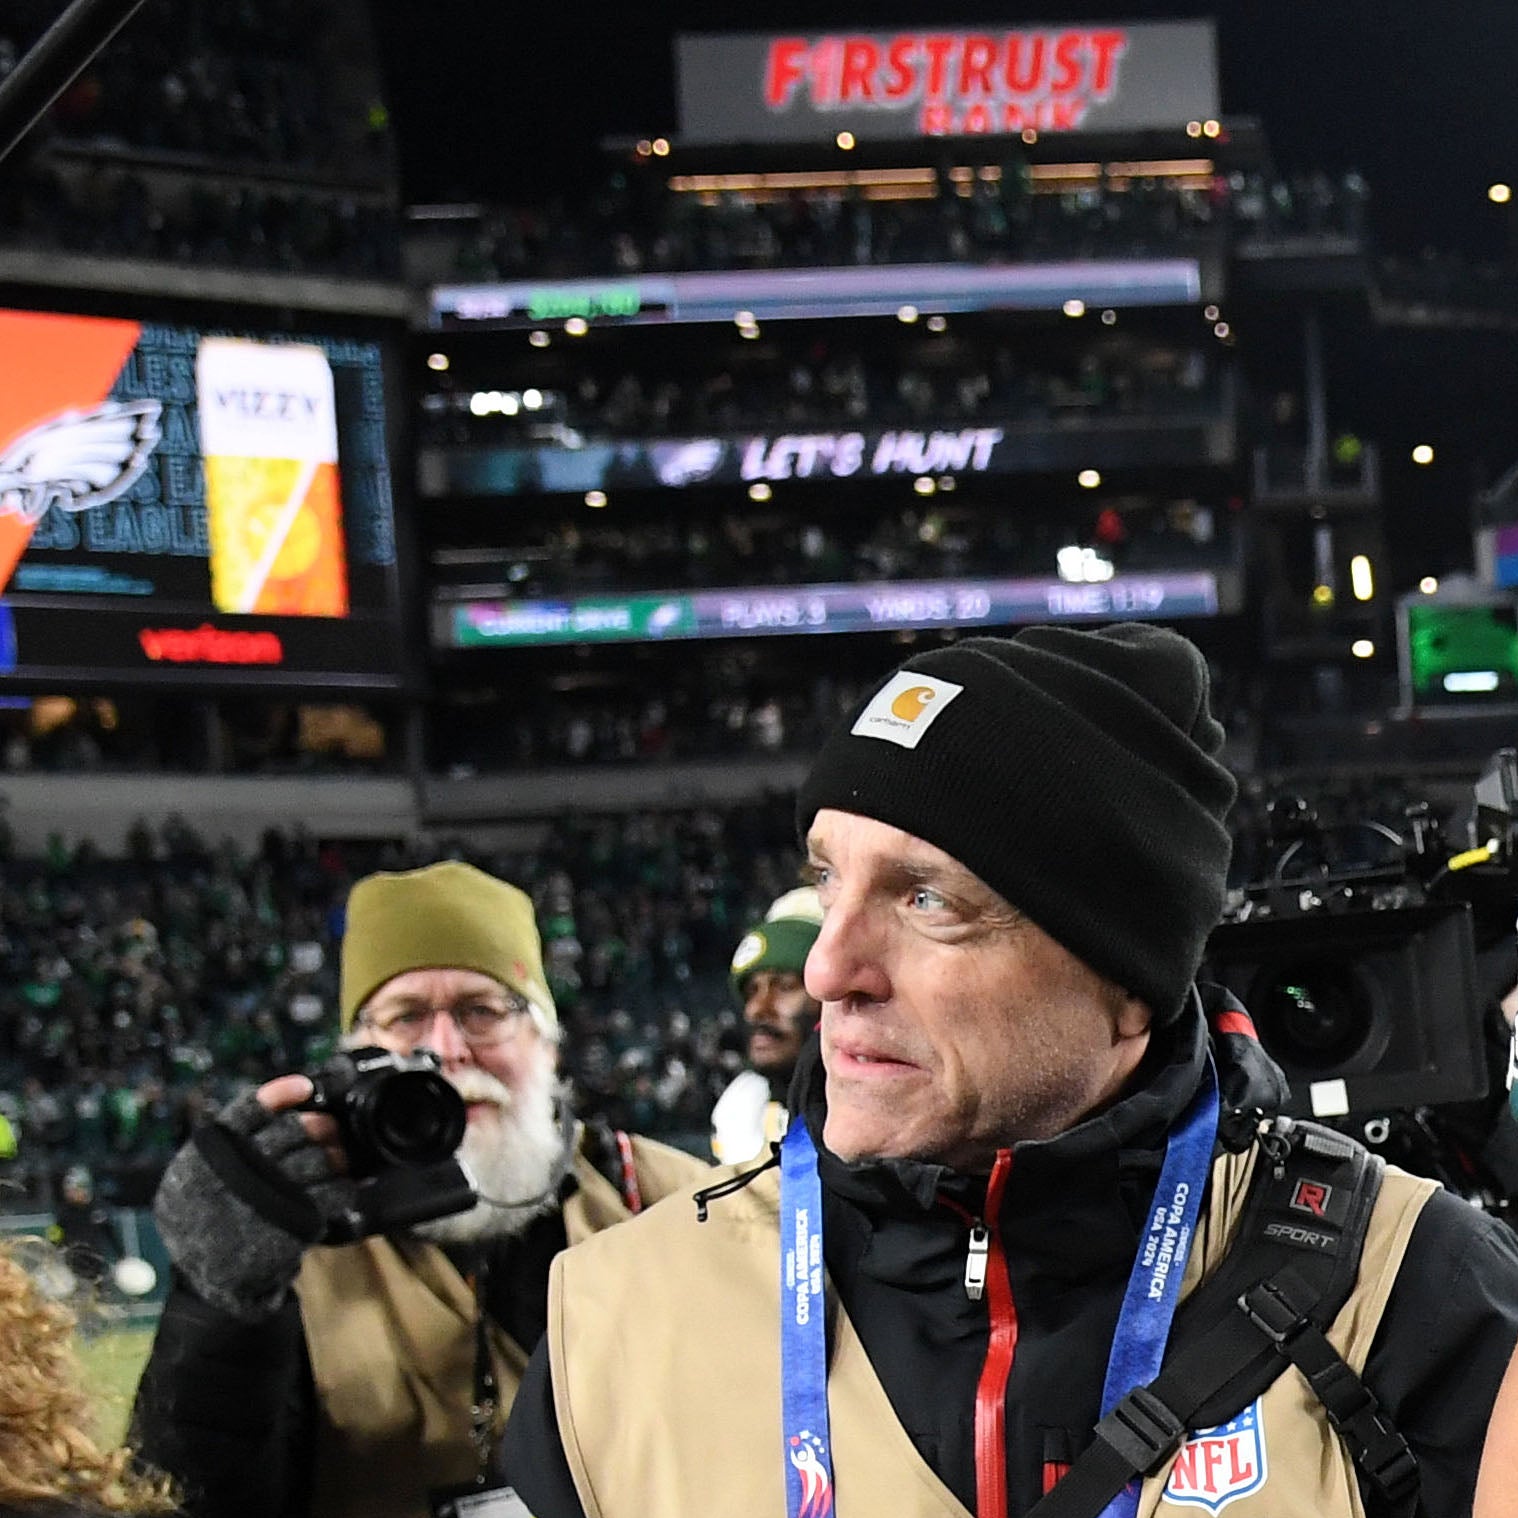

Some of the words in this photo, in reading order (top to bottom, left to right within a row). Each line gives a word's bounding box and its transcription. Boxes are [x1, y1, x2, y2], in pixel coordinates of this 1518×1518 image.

[872, 428, 1004, 475] HUNT
[1151, 1206, 1168, 1231] USA
[1168, 1182, 1189, 1225] COPA
[1296, 1182, 1326, 1217] R
[1141, 1235, 1160, 1267] 2024
[1263, 1223, 1335, 1248] SPORT
[1148, 1226, 1178, 1299] AMERICA
[1172, 1437, 1253, 1494] NFL
